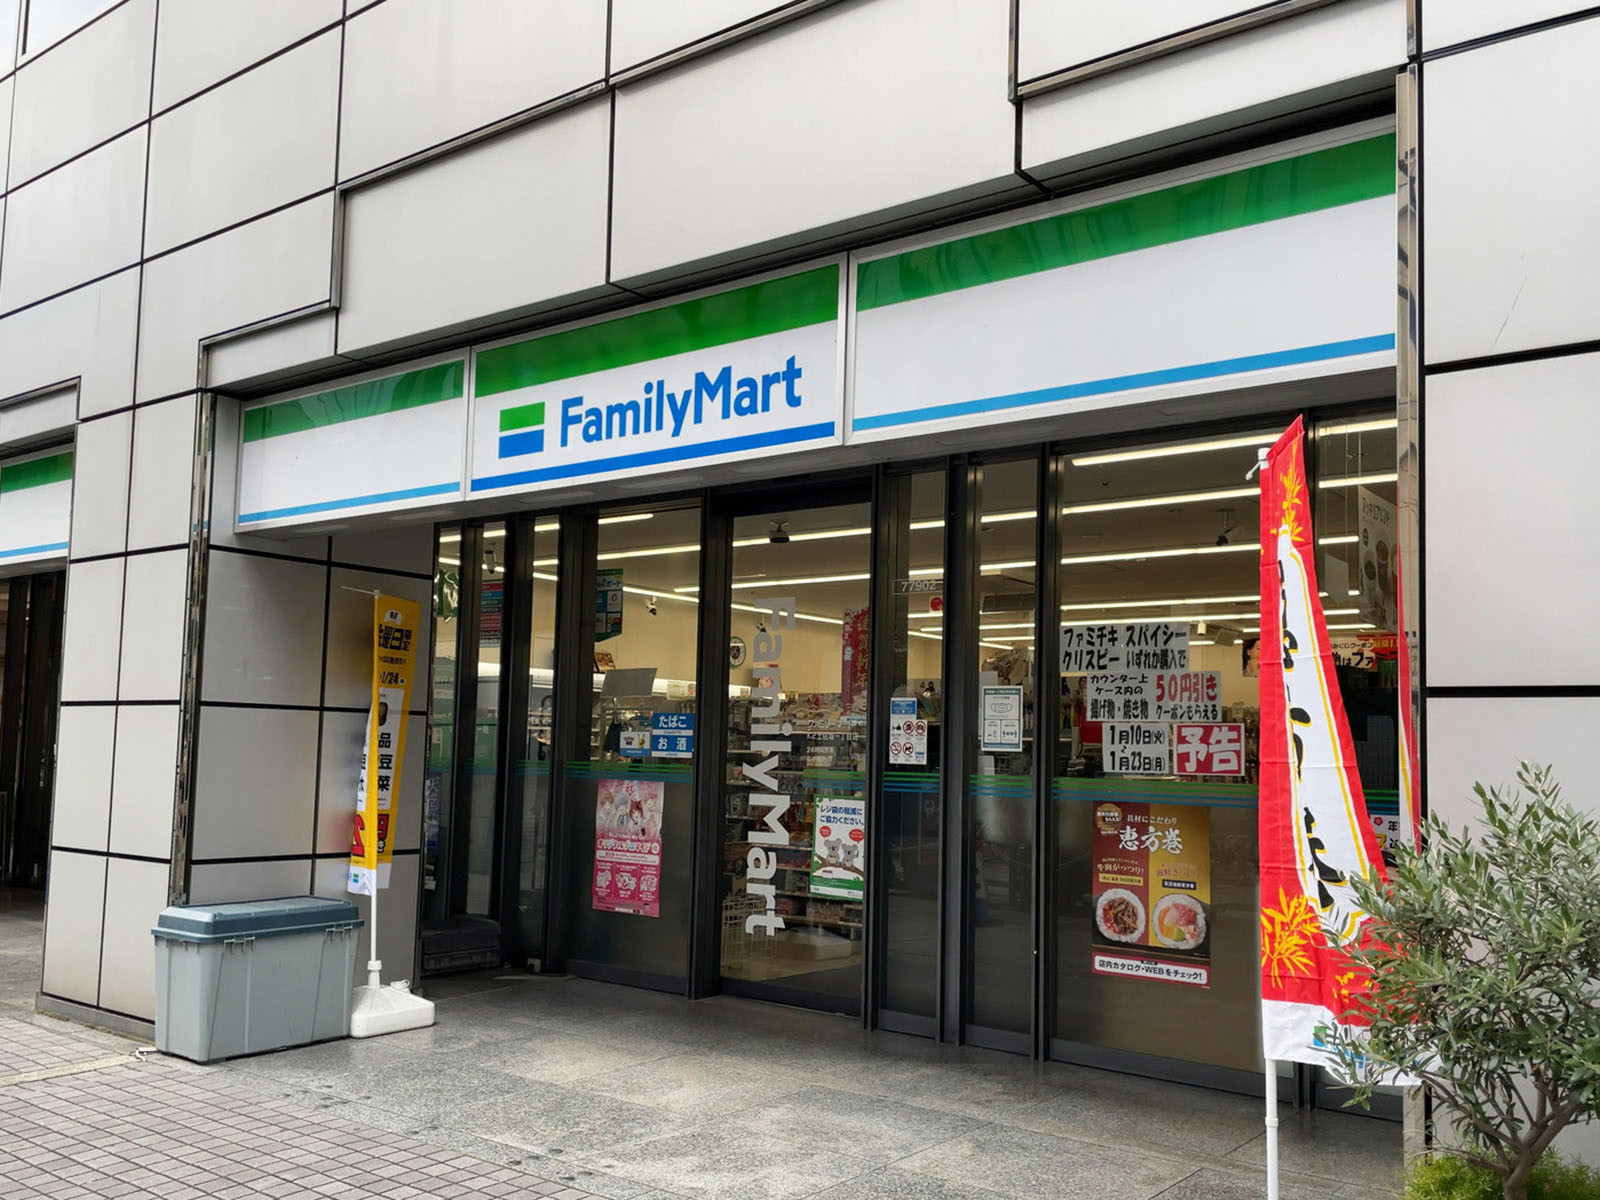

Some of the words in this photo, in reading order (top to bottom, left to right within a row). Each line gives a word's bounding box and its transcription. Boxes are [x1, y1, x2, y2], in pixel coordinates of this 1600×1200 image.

[561, 355, 802, 447] FamilyMart
[901, 581, 937, 592] 77902
[1064, 626, 1118, 648] ファミチキ
[1126, 624, 1187, 647] スパイシー
[1063, 648, 1120, 670] クリスピー
[1126, 650, 1186, 670] いずれか購入で
[1091, 674, 1149, 685] カウンター上
[1156, 673, 1217, 703] 50円引き
[1095, 686, 1143, 696] ケース内の
[1090, 699, 1149, 720] 揚げ物・焼き物
[1156, 705, 1218, 720] クーポンもらえる
[658, 715, 687, 728] たばこ
[1177, 726, 1241, 772] 予告
[742, 597, 796, 937] FamilyMart
[1127, 814, 1177, 825] 具材にこだわり
[1119, 825, 1183, 855] 恵方巻
[1098, 959, 1202, 981] 店内カタログ・WEBをチェック!
